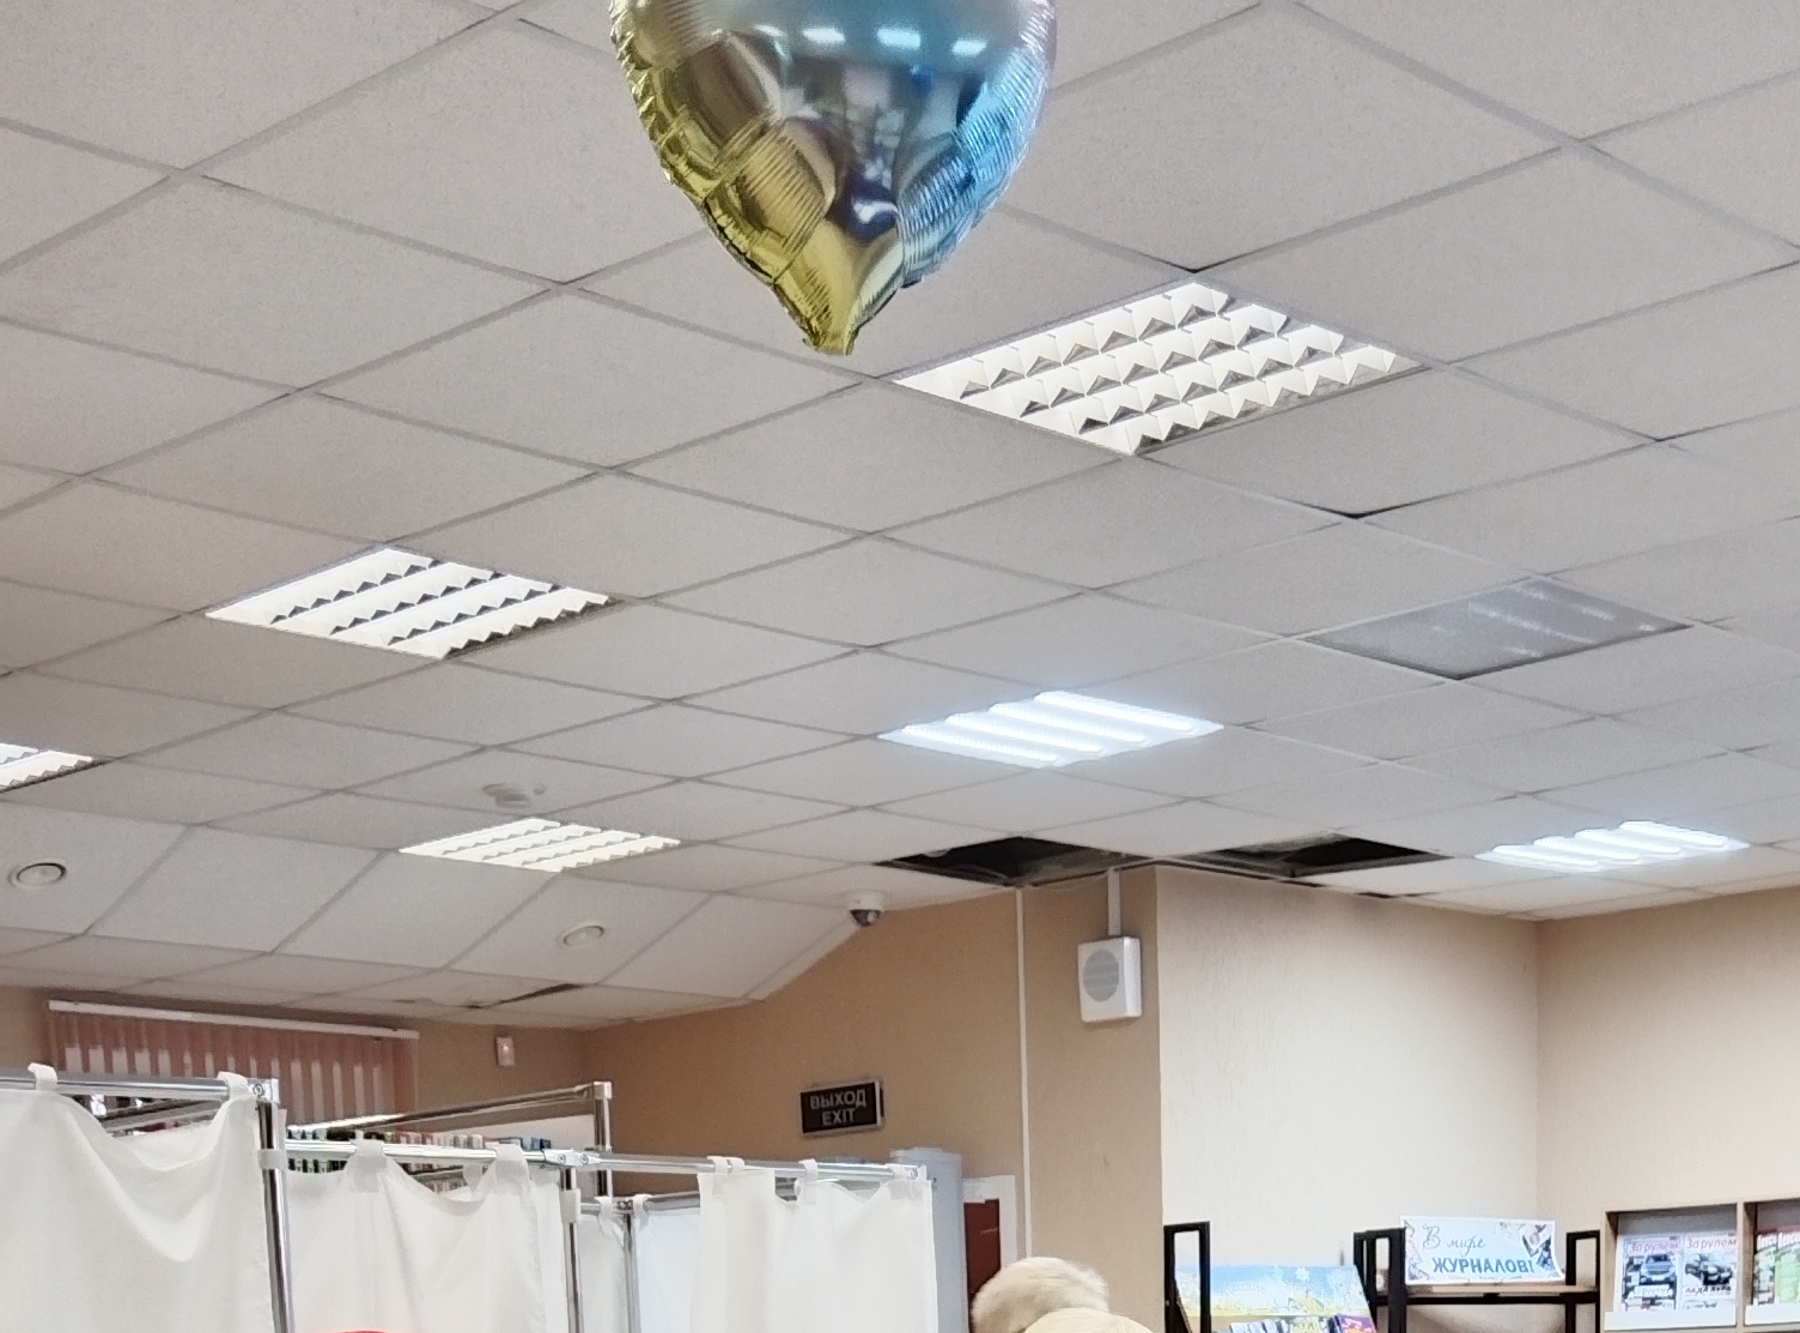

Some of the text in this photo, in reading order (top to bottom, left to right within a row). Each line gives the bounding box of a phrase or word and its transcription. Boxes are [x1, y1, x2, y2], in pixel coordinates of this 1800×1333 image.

[809, 1089, 867, 1110] ВЫХОД
[821, 1107, 856, 1126] EXIT
[1422, 1223, 1487, 1257] В мире
[1432, 1257, 1536, 1274] ЖУРНАЛОВ!
